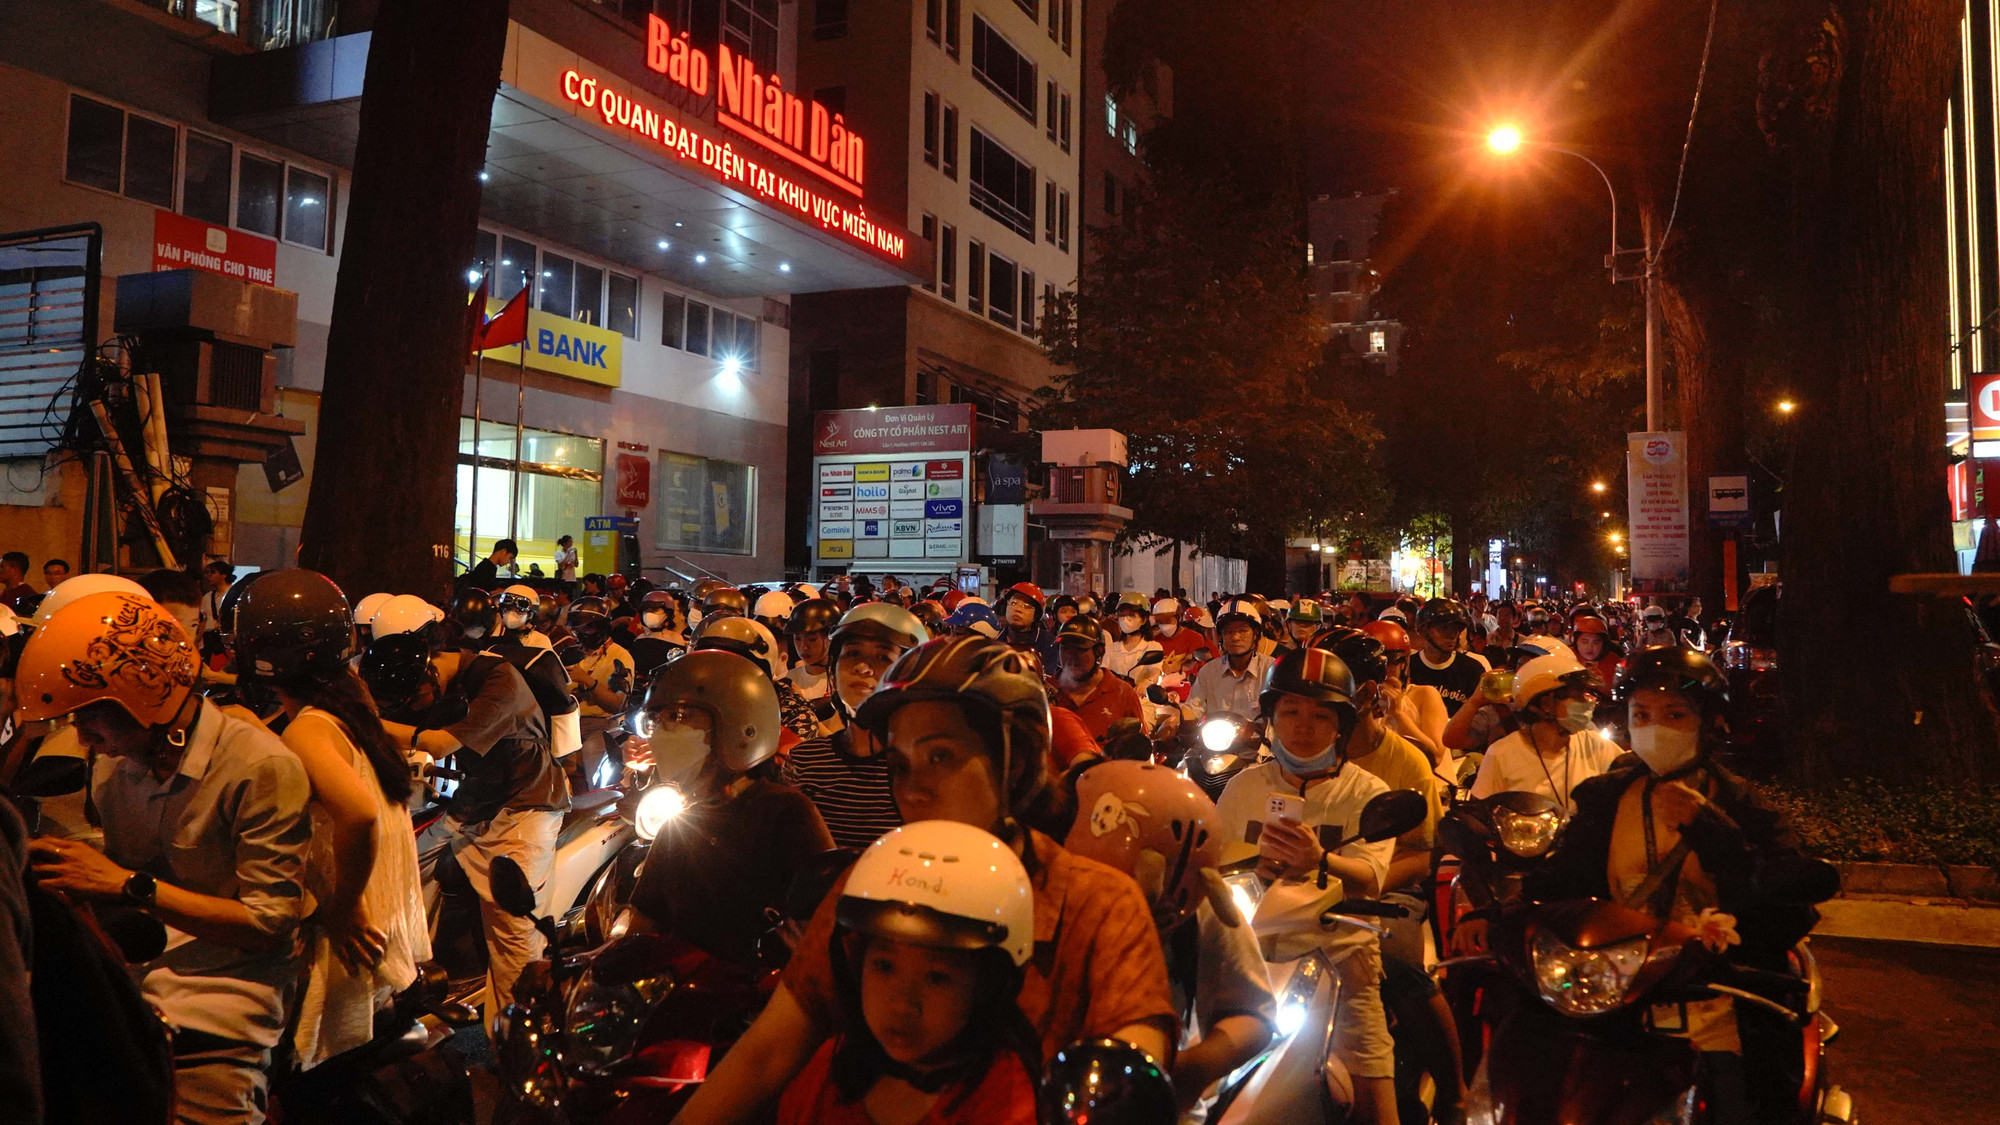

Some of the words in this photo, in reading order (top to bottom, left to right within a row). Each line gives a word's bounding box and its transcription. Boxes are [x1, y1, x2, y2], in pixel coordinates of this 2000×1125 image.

[647, 12, 708, 97] Báo
[717, 42, 804, 152] Nhân
[810, 100, 864, 185] Dân
[564, 70, 597, 108] CƠ
[601, 89, 659, 140] QUAN
[663, 119, 698, 159] ĐẠI
[702, 138, 744, 182] DIỆN
[748, 162, 775, 197] TẠI
[778, 177, 810, 213] KHU
[812, 194, 840, 228] VỰC
[843, 204, 875, 245] MIỀN
[877, 227, 904, 259] NAM
[157, 243, 181, 261] VĂN
[183, 250, 221, 271] PHÒNG
[223, 260, 245, 276] CHO
[247, 265, 273, 284] THUÊ
[538, 328, 608, 369] BANK
[885, 414, 899, 423] Đơn
[900, 414, 907, 423] Vị
[907, 413, 926, 423] Quản
[927, 412, 935, 423] Lý
[853, 427, 877, 439] CÔNG
[878, 428, 889, 438] TY
[890, 424, 901, 437] CỔ
[928, 425, 949, 435] NEST
[950, 424, 968, 434] ART
[819, 440, 835, 448] Nest
[836, 439, 847, 447] Art
[893, 468, 912, 476] palma
[1002, 477, 1021, 487] spa
[619, 488, 635, 499] Nest
[855, 507, 878, 515] MIMS
[931, 503, 957, 512] vivo
[588, 518, 611, 529] ATM
[982, 523, 1018, 534] VICHY
[822, 526, 850, 534] Cominix
[432, 543, 449, 558] 116
[887, 867, 948, 896] Hond
